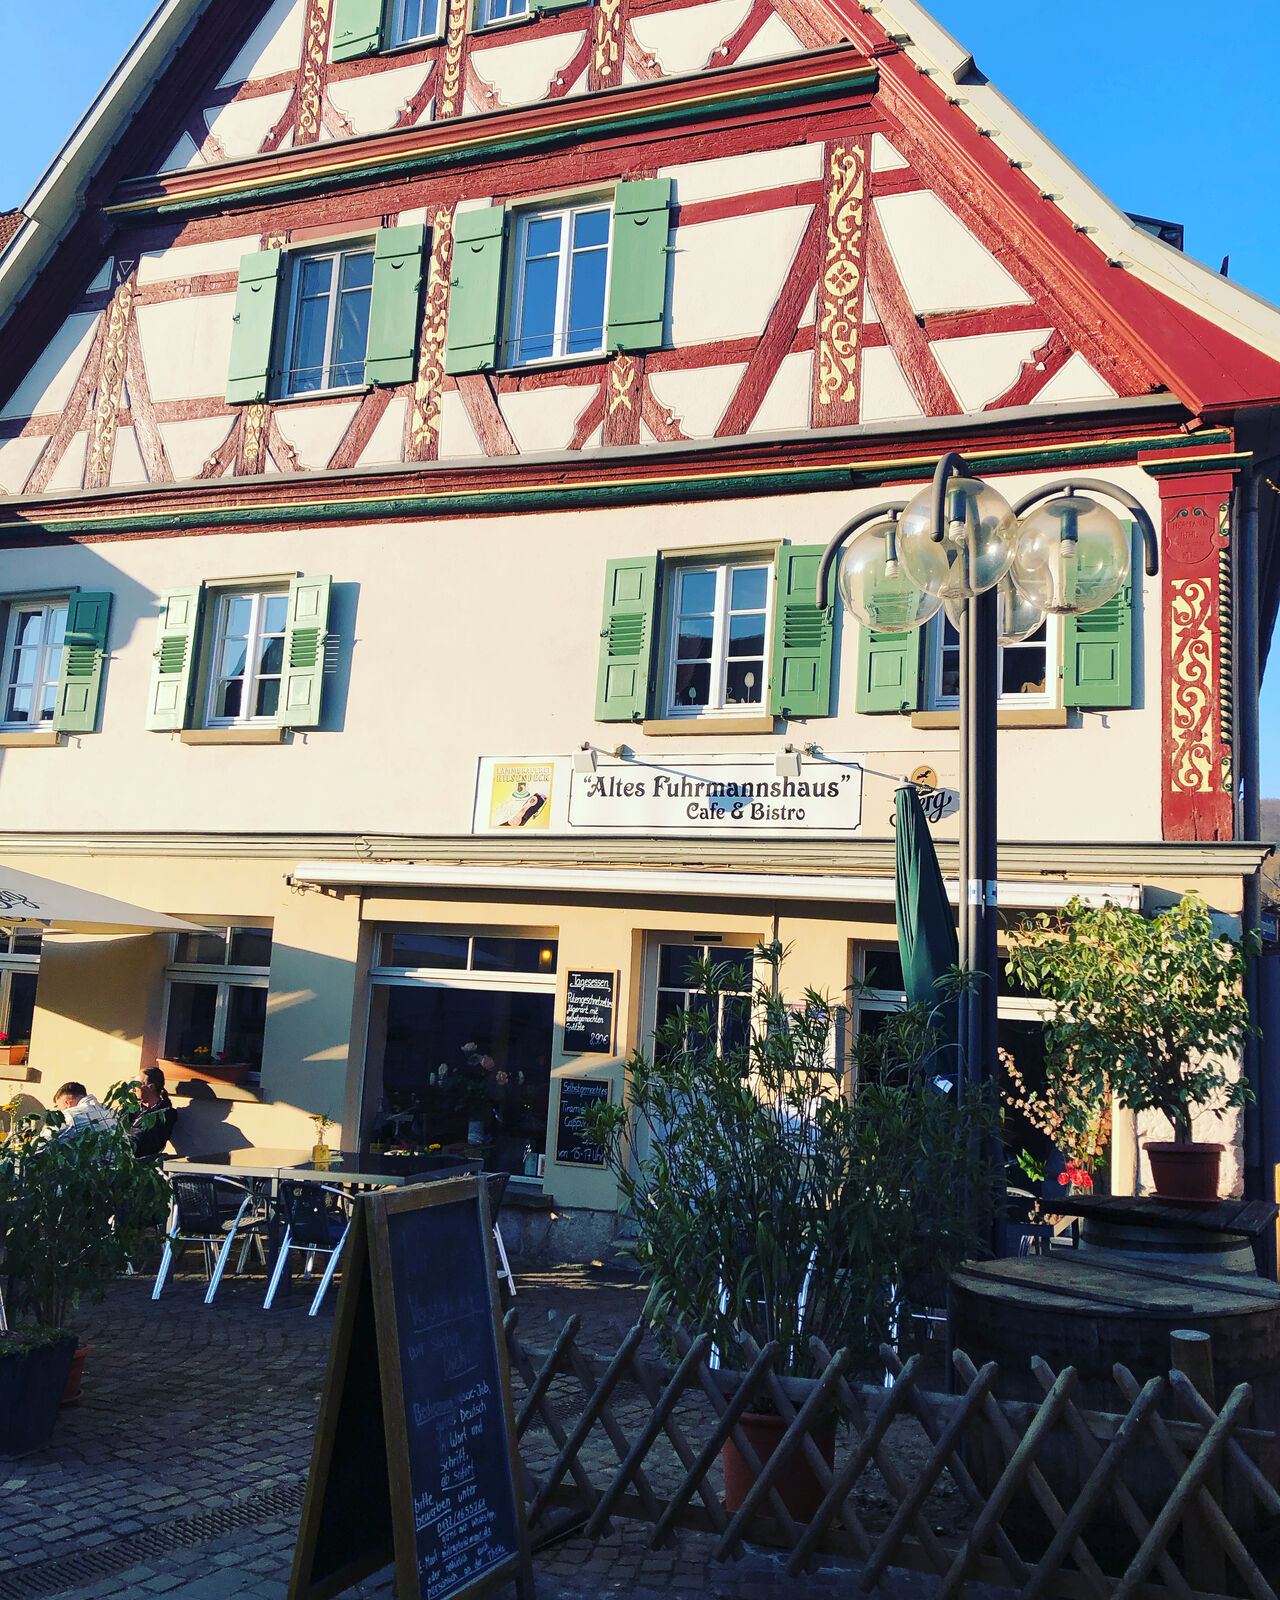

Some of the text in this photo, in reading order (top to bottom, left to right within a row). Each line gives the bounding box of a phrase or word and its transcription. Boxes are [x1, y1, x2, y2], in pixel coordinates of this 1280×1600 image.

[686, 802, 807, 820] Cafe & Bistro
[571, 974, 610, 991] Tagesessen
[589, 1007, 599, 1015] mit
[561, 1100, 587, 1115] Tiramis
[449, 1426, 468, 1448] Wort
[415, 1492, 433, 1514] bitte
[415, 1498, 451, 1530] bewerben
